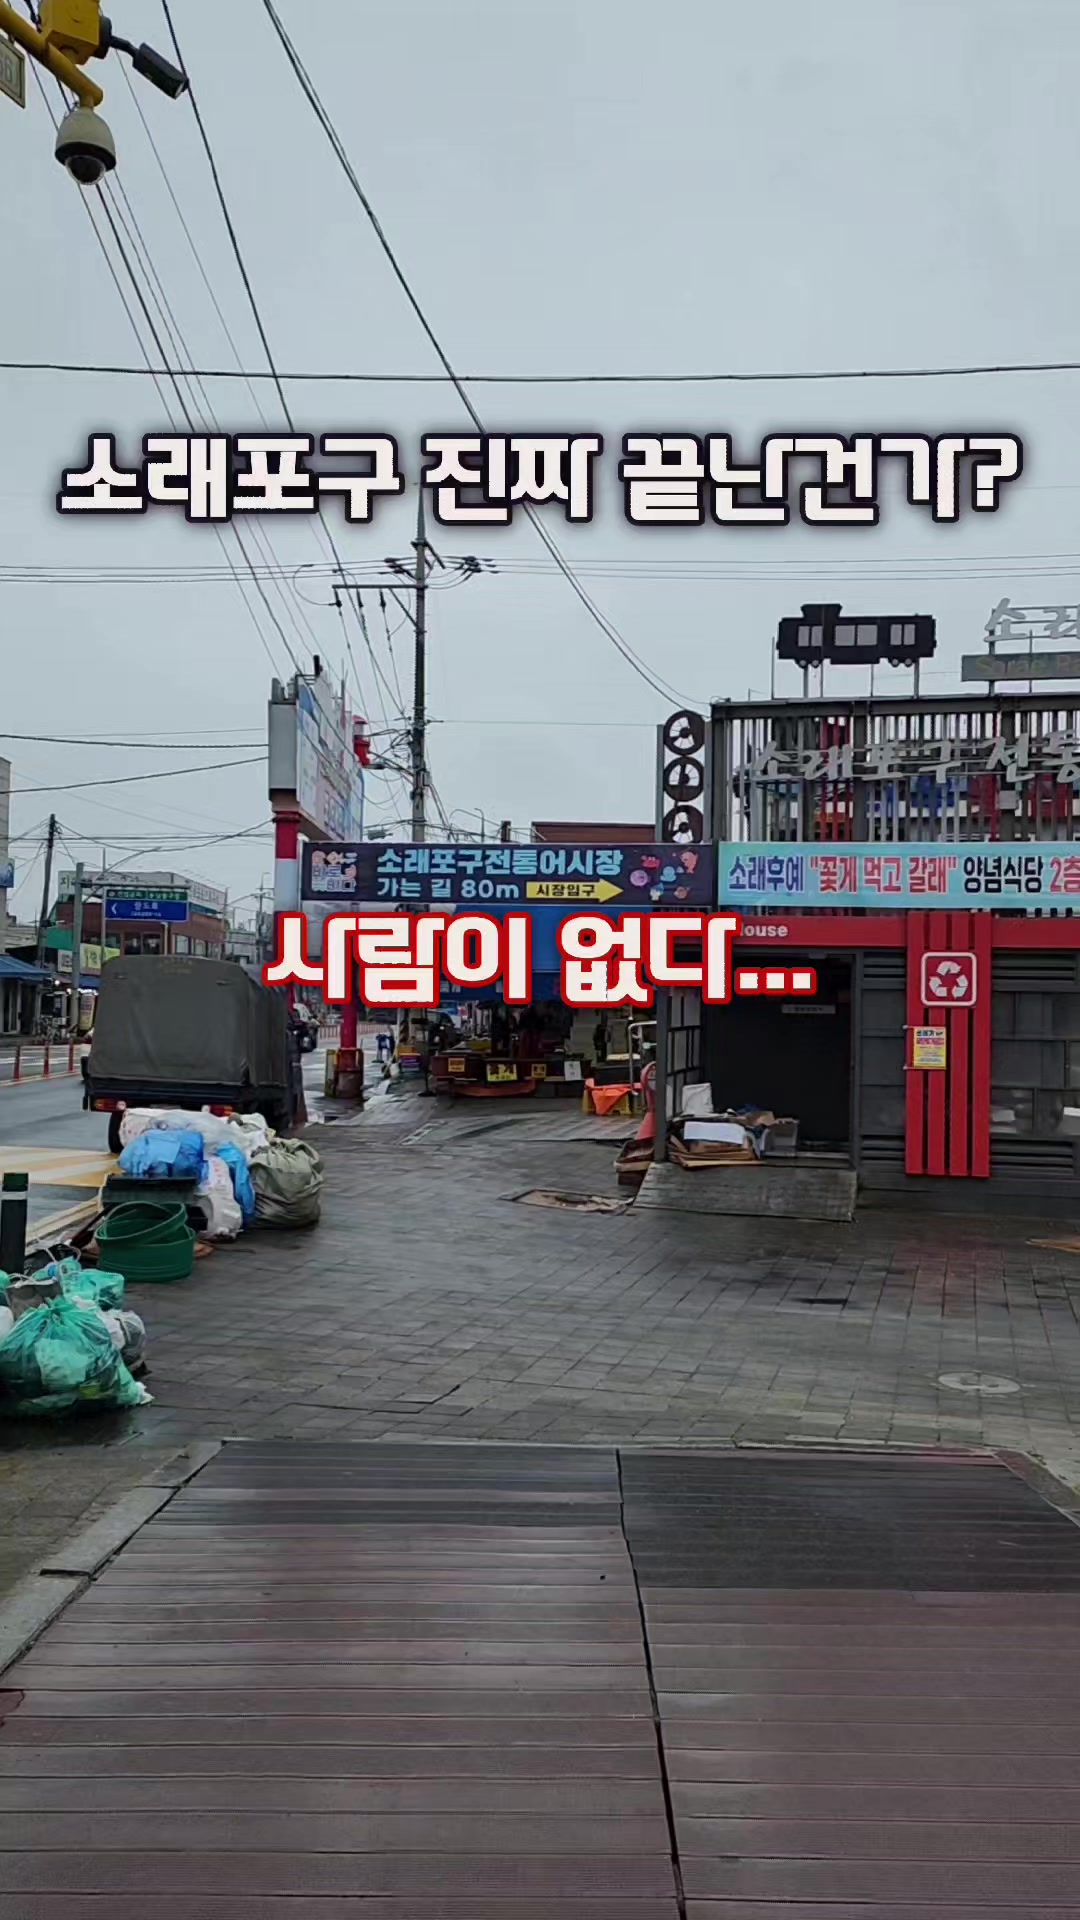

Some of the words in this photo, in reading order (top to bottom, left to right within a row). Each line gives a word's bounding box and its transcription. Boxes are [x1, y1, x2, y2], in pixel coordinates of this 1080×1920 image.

[377, 848, 623, 875] 소래포구전통어시장
[728, 855, 804, 892] 소래후예
[810, 855, 857, 893] "꽃게
[863, 856, 902, 893] 먹고
[908, 856, 957, 894] 갈래"
[963, 855, 1045, 894] 양념식당
[377, 878, 421, 898] 가는
[431, 879, 451, 898] 길
[461, 879, 519, 898] 80m
[536, 883, 596, 897] 시장입구
[741, 922, 789, 937] ouse
